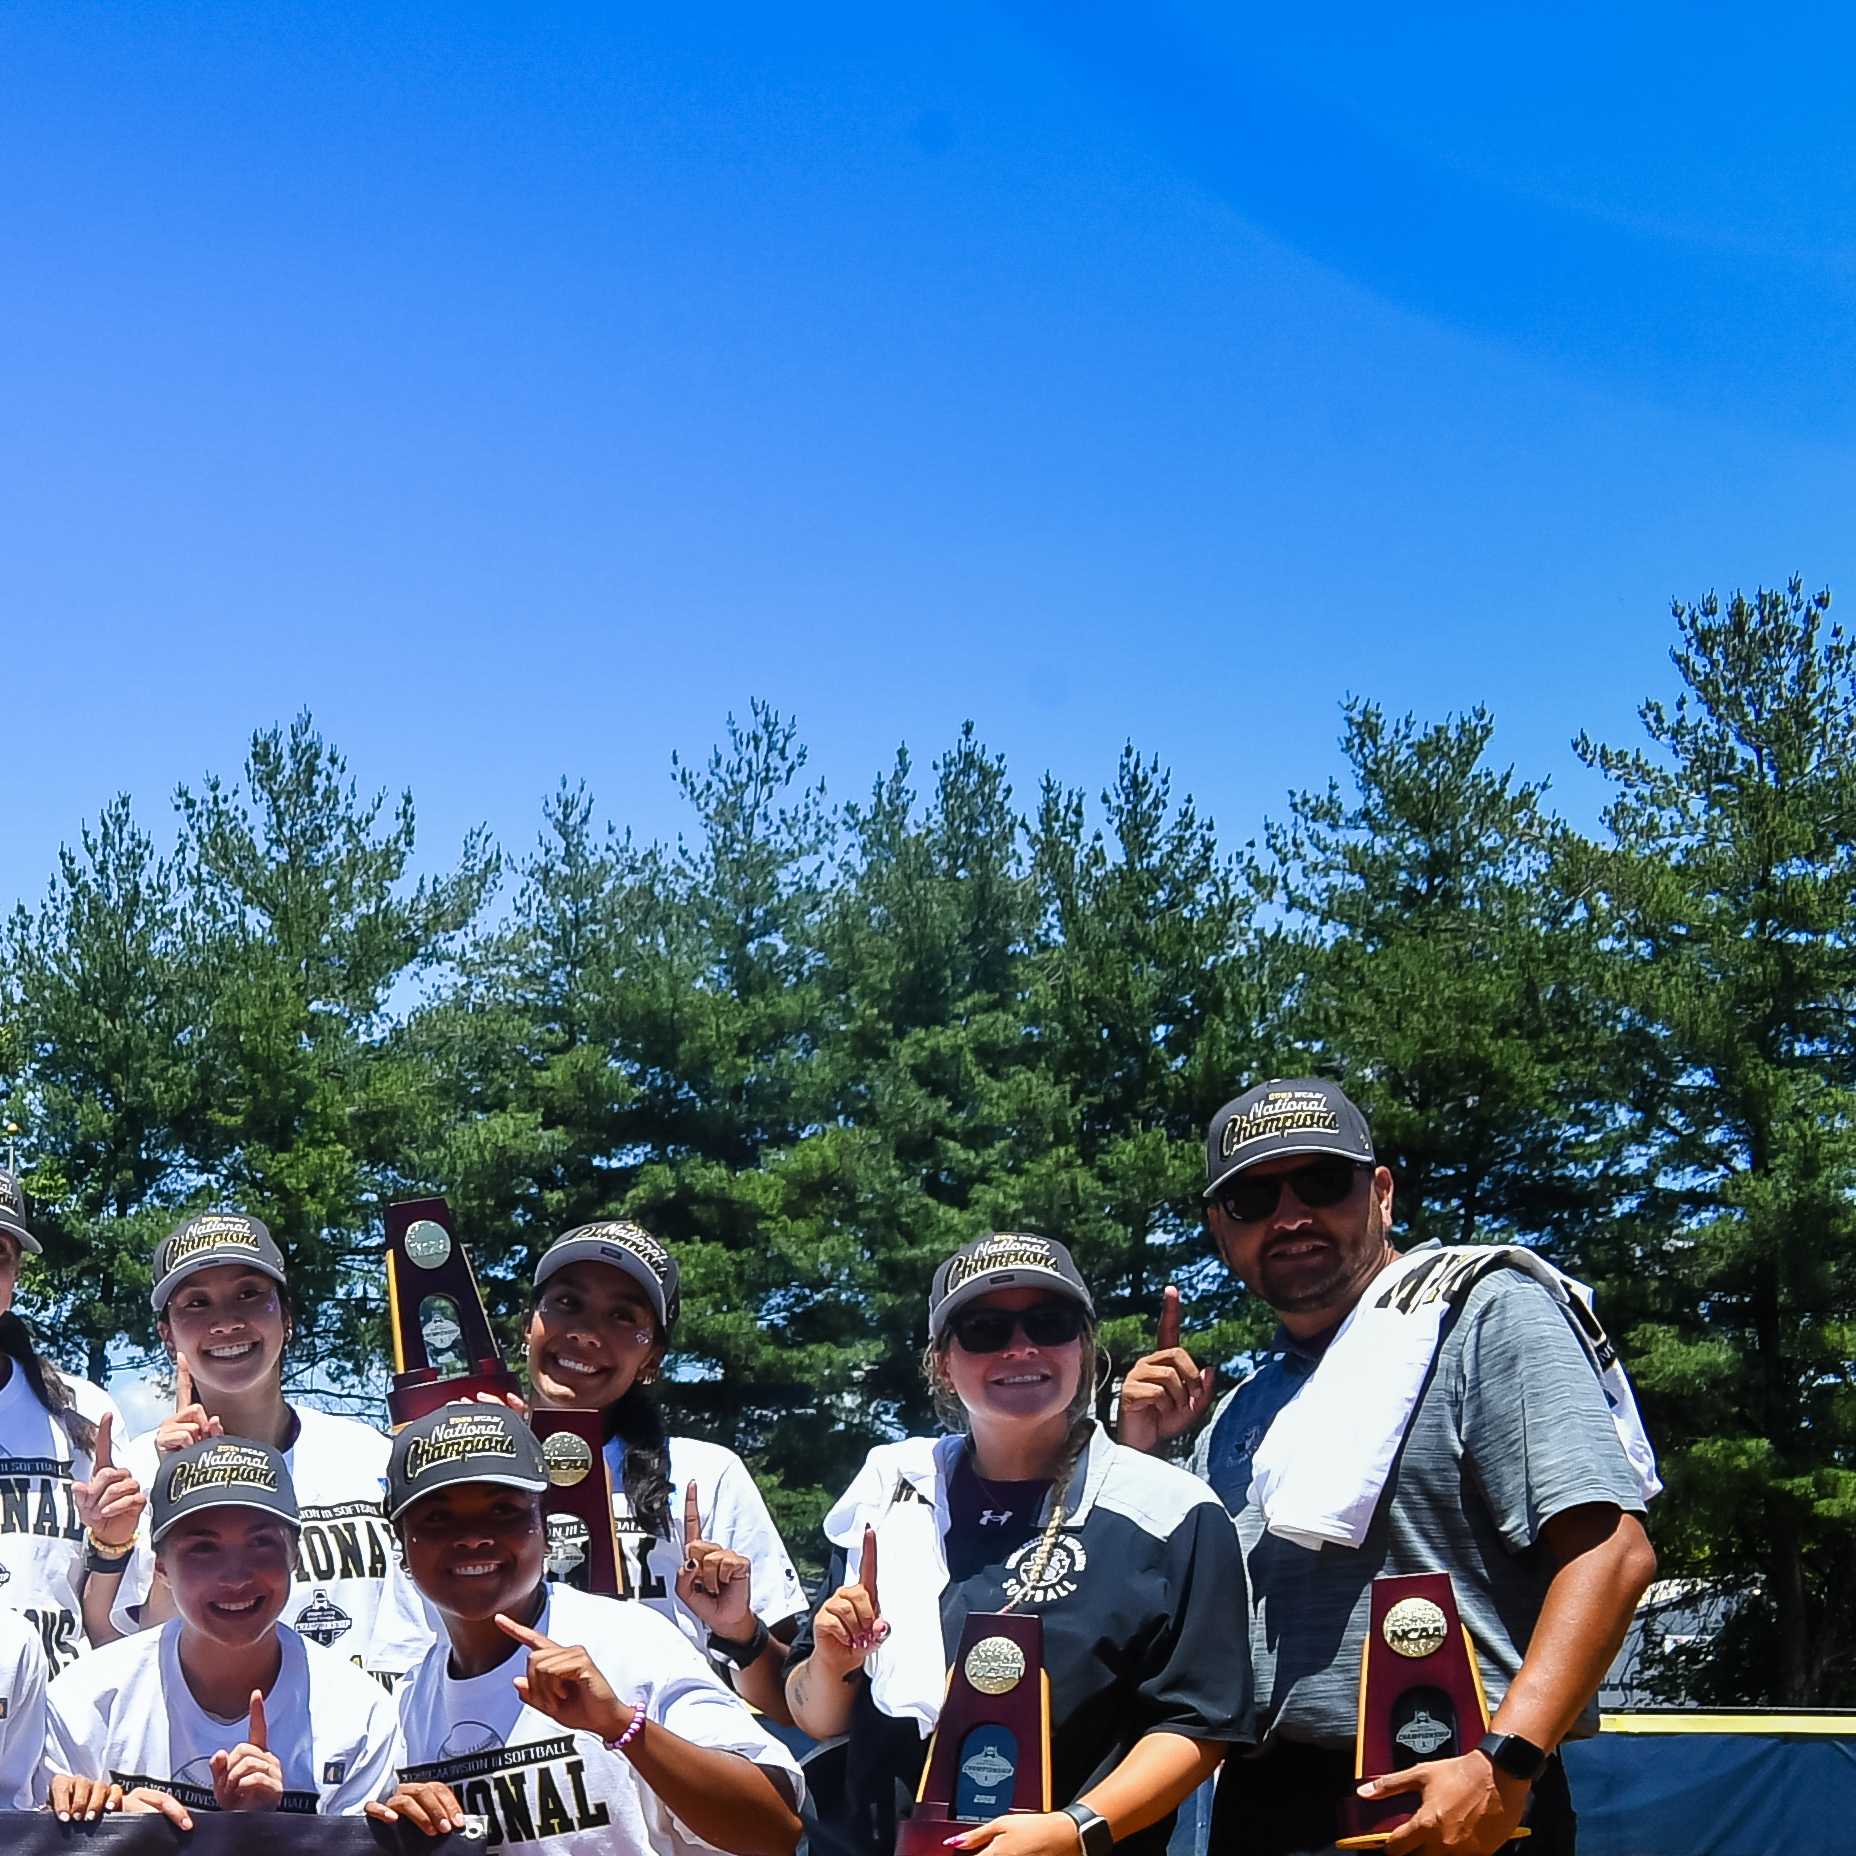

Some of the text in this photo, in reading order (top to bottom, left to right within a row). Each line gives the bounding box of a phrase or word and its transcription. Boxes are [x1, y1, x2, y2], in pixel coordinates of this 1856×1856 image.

[1249, 1096, 1328, 1117] National
[1219, 1111, 1339, 1162] Champions
[187, 1220, 251, 1236] National
[163, 1233, 260, 1273] Champions
[975, 1238, 1051, 1259] National
[431, 1422, 505, 1441] National
[198, 1451, 270, 1468] National
[405, 1436, 517, 1484] Champions
[169, 1461, 278, 1506] Champions
[1002, 1578, 1078, 1602] SOTBALL
[1390, 1627, 1444, 1643] NCAA
[504, 1741, 569, 1765] SOFTBALL
